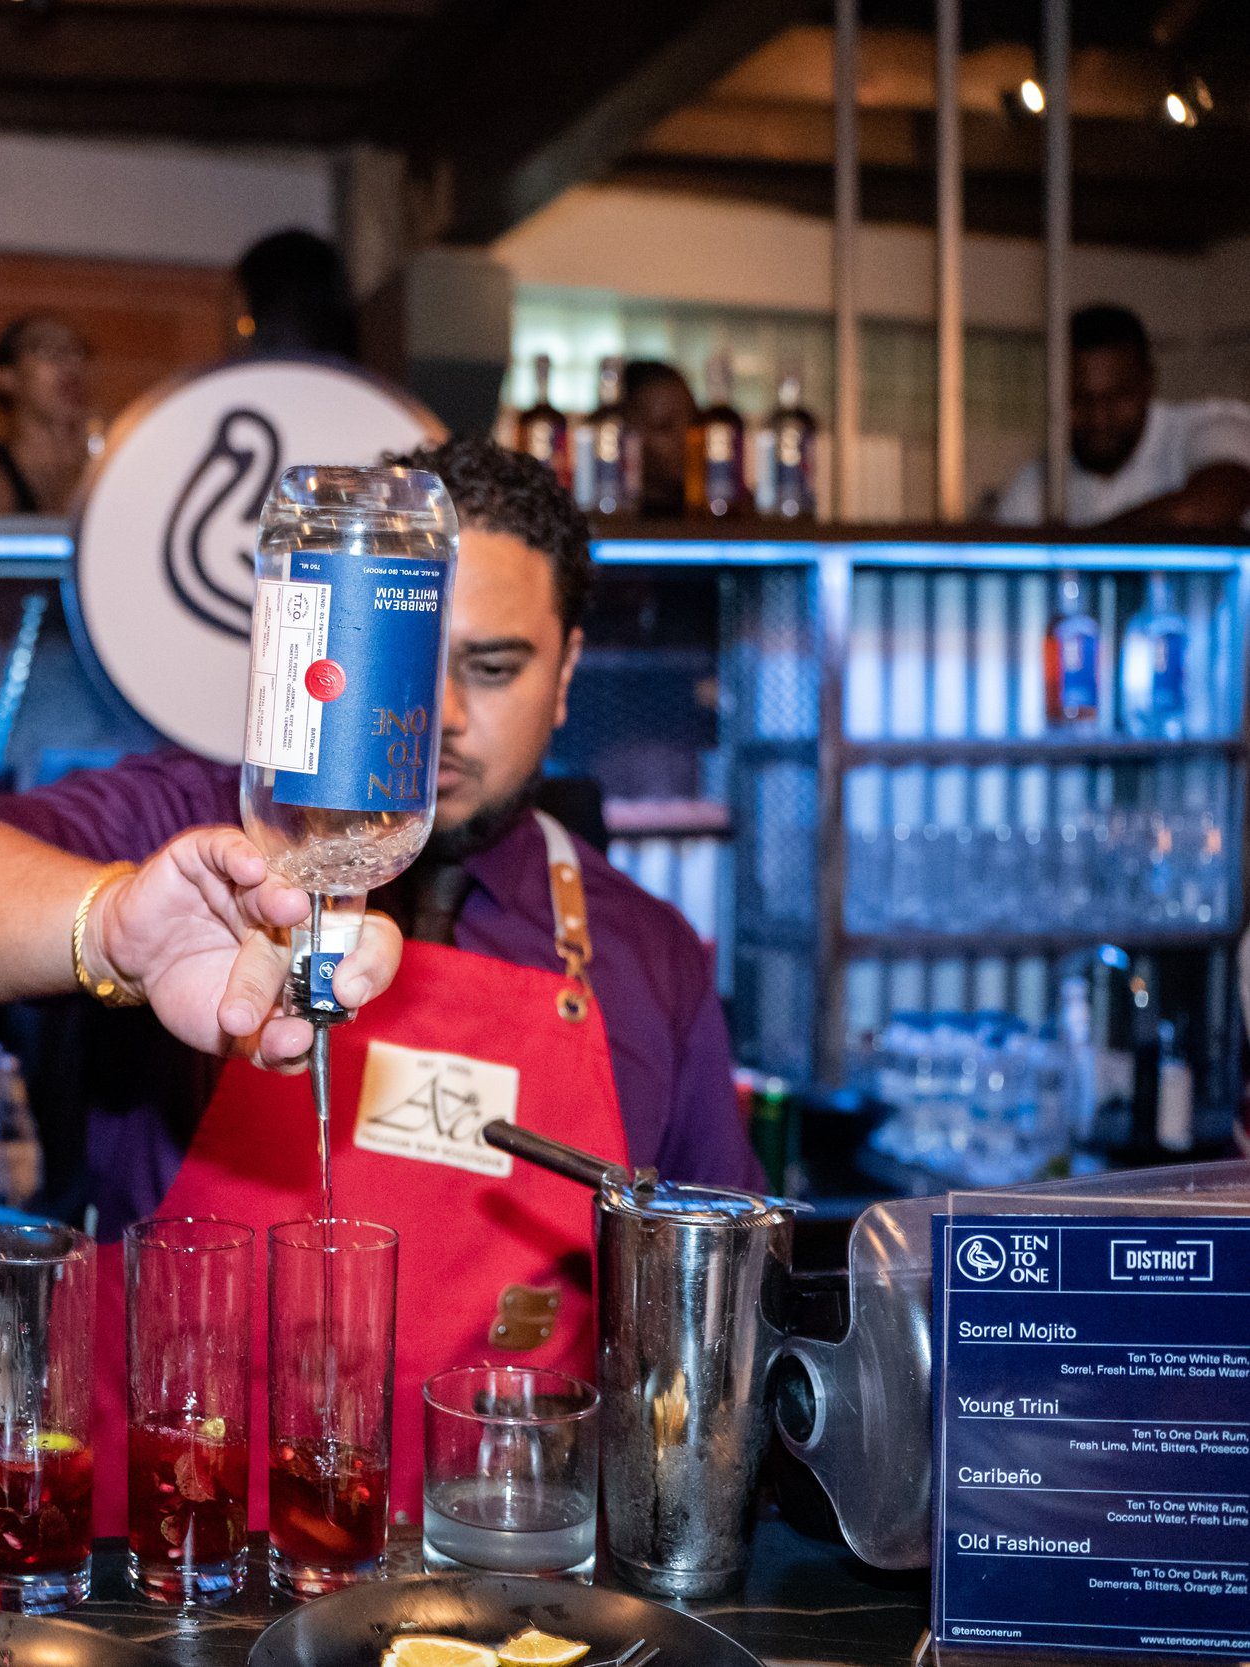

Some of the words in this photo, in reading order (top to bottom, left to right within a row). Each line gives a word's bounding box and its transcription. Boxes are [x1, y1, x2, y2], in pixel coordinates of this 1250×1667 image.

[376, 588, 404, 598] RUM
[409, 589, 438, 600] WHITE
[293, 593, 302, 622] T.T.O.
[374, 599, 437, 611] CARIBBEAN
[371, 707, 427, 737] ONE
[387, 736, 424, 768] TO
[368, 770, 421, 800] TEN
[367, 1075, 489, 1146] Ac
[1010, 1235, 1048, 1250] TEN
[1010, 1252, 1037, 1267] TO
[1126, 1251, 1196, 1270] DISTRICT
[1010, 1268, 1049, 1283] ONE
[959, 1321, 1012, 1339] Sorrel
[1020, 1323, 1077, 1342] Mojito
[1128, 1353, 1146, 1363] Ten
[1149, 1353, 1162, 1363] To
[1165, 1354, 1186, 1363] One
[1189, 1354, 1221, 1364] White
[1223, 1355, 1250, 1366] Rum,
[1061, 1364, 1094, 1375] Sorrel,
[1097, 1365, 1126, 1375] Fresh
[1129, 1366, 1156, 1377] Lime,
[1159, 1367, 1185, 1377] Mint,
[1188, 1367, 1216, 1377] Soda
[1219, 1368, 1250, 1378] Water
[958, 1397, 1014, 1417] Young
[1019, 1398, 1059, 1414] Trini
[1133, 1429, 1151, 1439] Ten
[1154, 1430, 1166, 1439] To
[1169, 1430, 1191, 1440] One
[1194, 1430, 1219, 1441] Dark
[1223, 1432, 1249, 1442] Rum,
[1070, 1441, 1098, 1450] Fresh
[1102, 1441, 1129, 1452] Lime,
[1132, 1442, 1158, 1452] Mint,
[1161, 1442, 1197, 1453] Bitters,
[1201, 1444, 1249, 1455] Prosecco
[958, 1467, 1041, 1485] Caribeño
[1126, 1500, 1145, 1510] Ten
[1148, 1501, 1161, 1511] To
[1163, 1502, 1185, 1511] One
[1188, 1502, 1219, 1512] White
[1222, 1503, 1248, 1514] Rum,
[1107, 1512, 1151, 1522] Coconut
[1155, 1513, 1188, 1525] Water,
[1190, 1514, 1219, 1525] Fresh
[1223, 1516, 1248, 1526] Lime
[958, 1534, 989, 1549] Old
[996, 1535, 1090, 1553] Fashioned
[1131, 1567, 1150, 1577] Ten
[1153, 1568, 1165, 1578] To
[1168, 1569, 1190, 1579] One
[1193, 1570, 1218, 1580] Dark
[1221, 1571, 1248, 1581] Rum,
[1089, 1579, 1142, 1590] Demerara,
[1145, 1581, 1181, 1592] Bitters,
[1184, 1582, 1222, 1594] Orange
[1225, 1584, 1248, 1594] Zest
[951, 1626, 1021, 1637] @tentoonerum
